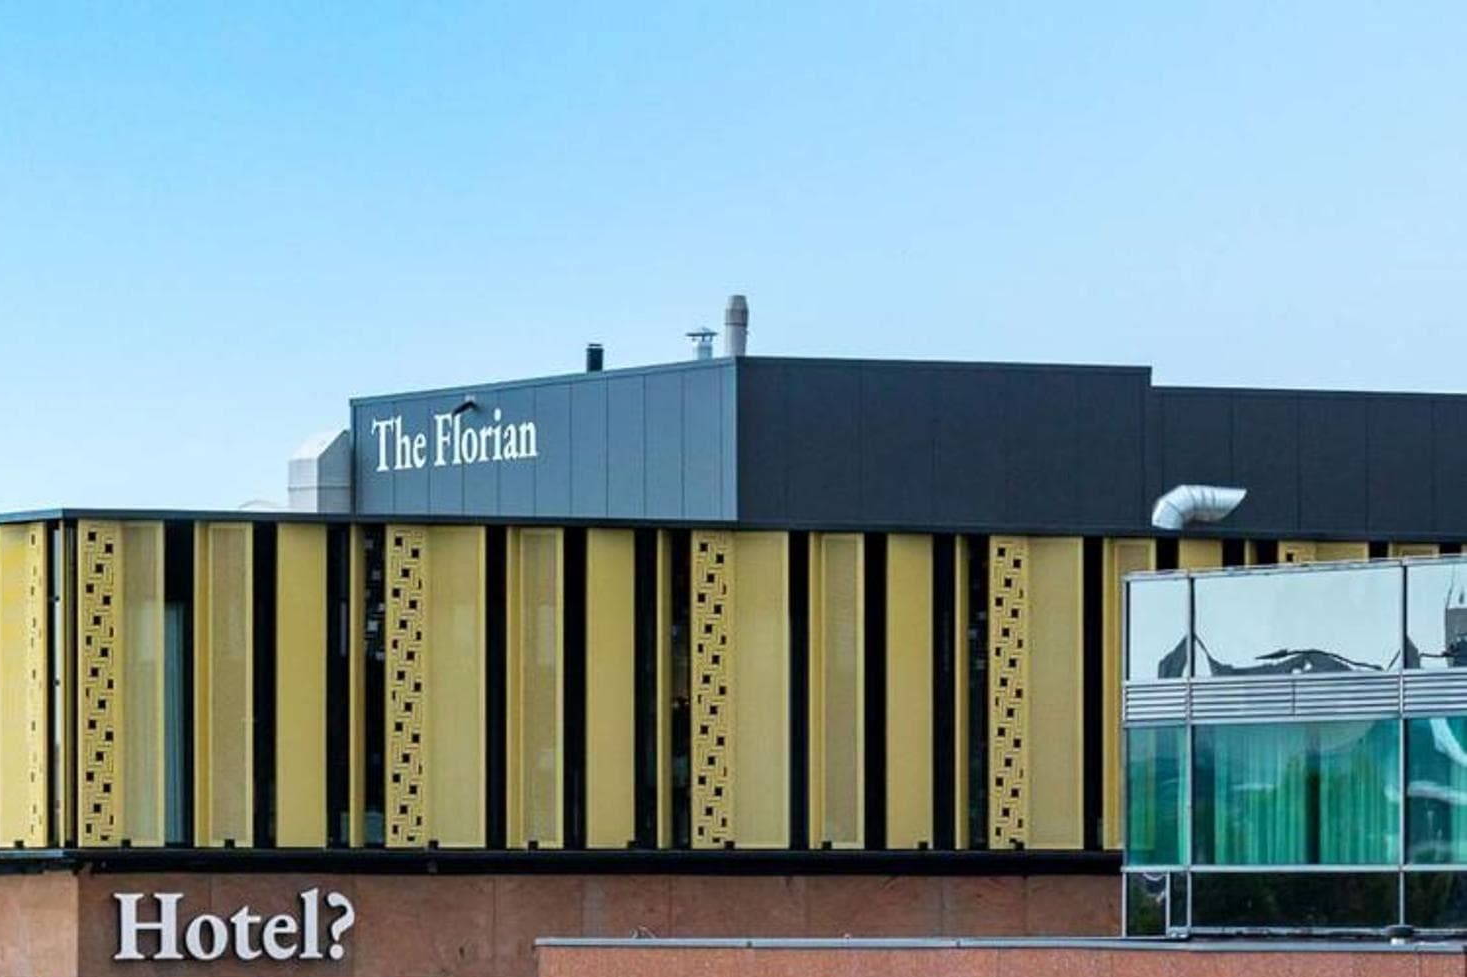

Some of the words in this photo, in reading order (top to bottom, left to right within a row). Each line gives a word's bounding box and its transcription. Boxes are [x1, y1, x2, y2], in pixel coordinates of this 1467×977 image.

[371, 415, 427, 472] The
[434, 408, 538, 467] Florian
[113, 887, 355, 960] Hotel?
